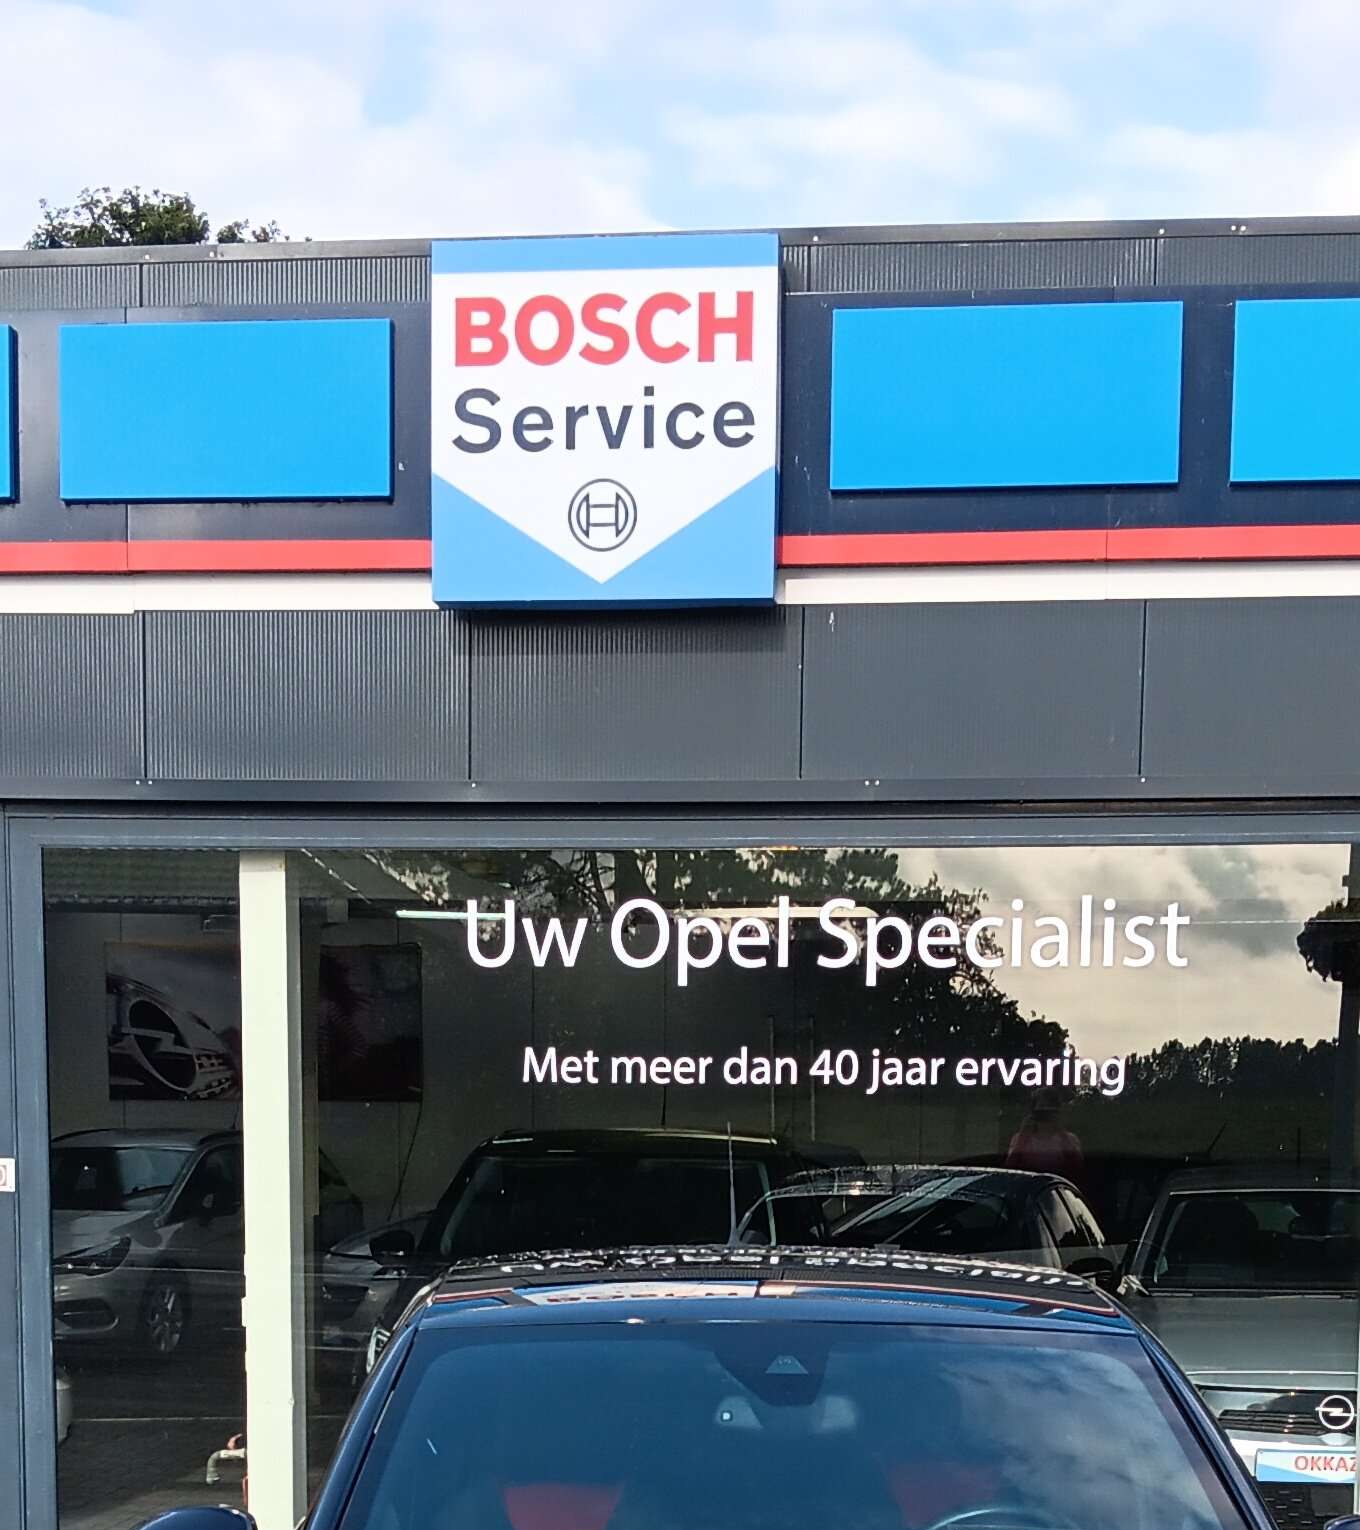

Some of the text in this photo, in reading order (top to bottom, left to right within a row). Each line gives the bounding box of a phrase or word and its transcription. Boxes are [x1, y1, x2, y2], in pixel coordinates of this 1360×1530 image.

[456, 292, 753, 365] BOSCH
[453, 386, 754, 453] Service
[465, 896, 1190, 986] Uw Opel Specialist
[522, 1047, 1127, 1095] Met meer dan 40 jaar ervaring
[1295, 1455, 1357, 1472] OKKAZ
